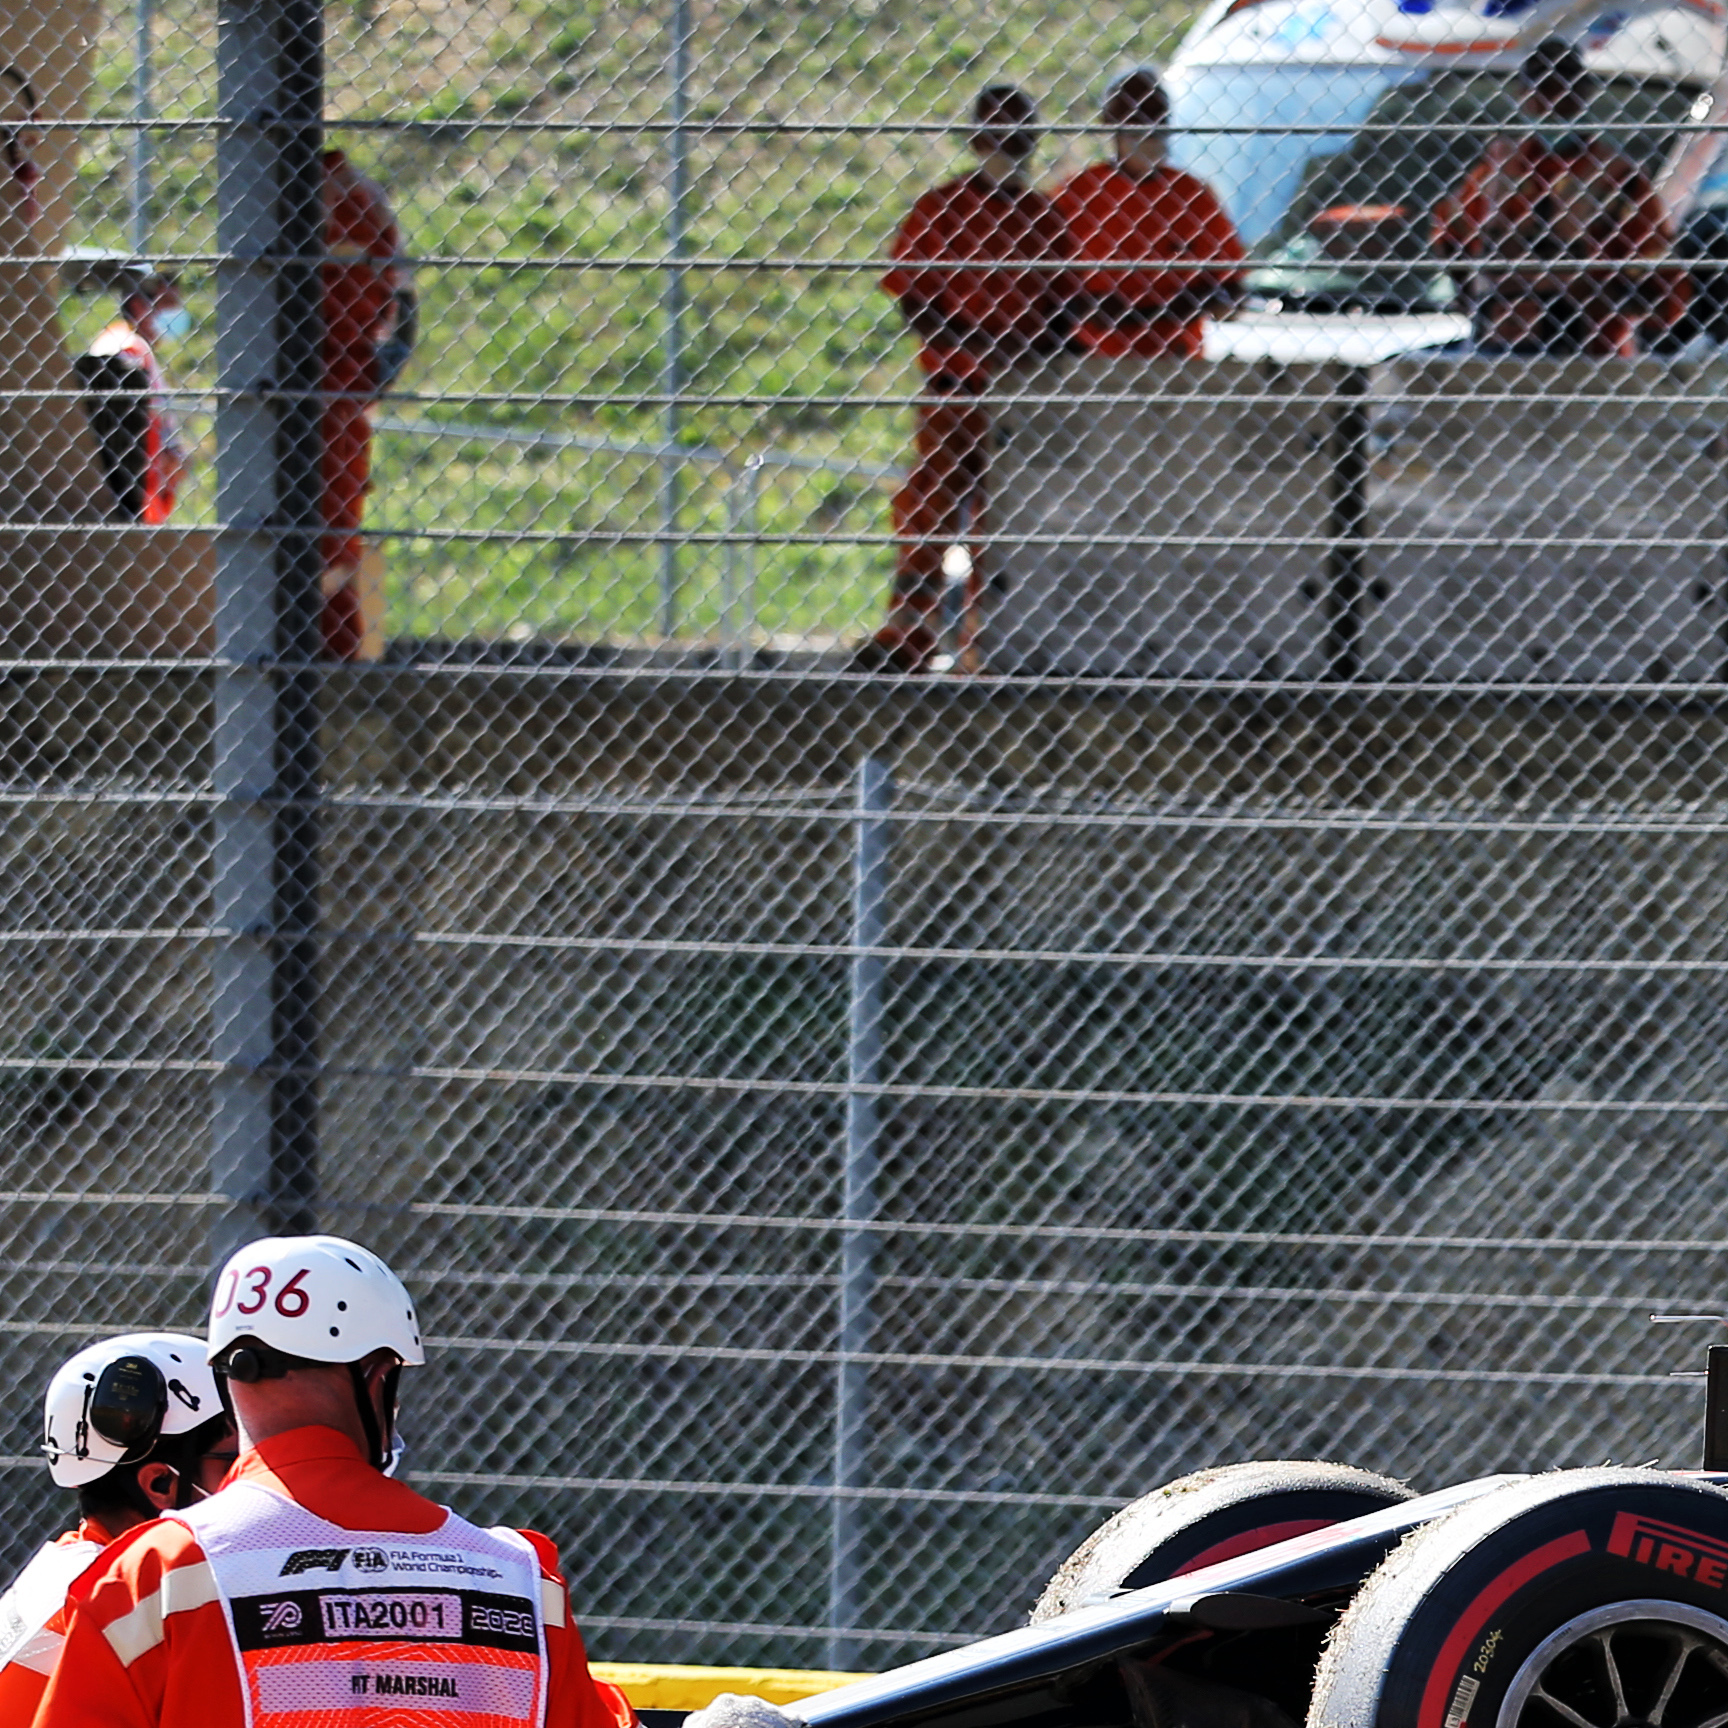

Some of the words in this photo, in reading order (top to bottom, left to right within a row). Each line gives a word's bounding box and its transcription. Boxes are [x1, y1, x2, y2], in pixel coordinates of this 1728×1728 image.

[215, 1265, 312, 1318] 036
[390, 1551, 411, 1563] FIA
[414, 1551, 457, 1564] Formula
[392, 1562, 427, 1573] World
[326, 1600, 445, 1630] ITA2001
[376, 1674, 459, 1698] MARSHAL
